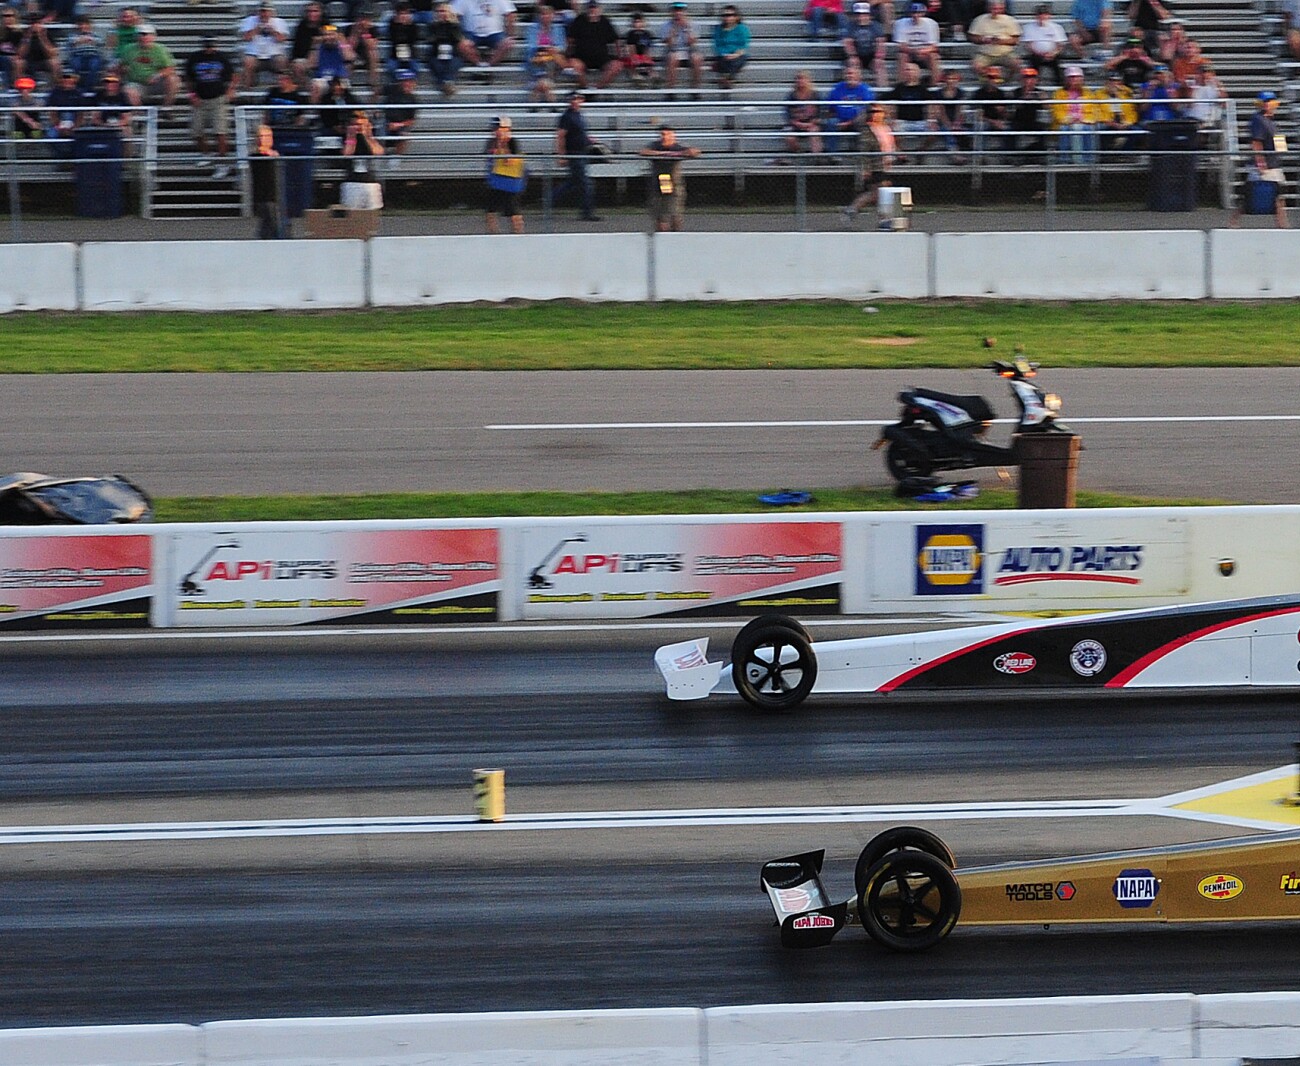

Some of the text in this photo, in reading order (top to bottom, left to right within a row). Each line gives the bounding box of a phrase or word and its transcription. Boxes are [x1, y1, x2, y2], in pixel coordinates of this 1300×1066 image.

[1000, 546, 1145, 572] AUTO PARTS
[623, 562, 684, 572] LIFTS
[275, 569, 337, 579] LIFTS
[1006, 884, 1053, 892] MATCO
[1119, 879, 1155, 898] NAPA
[1203, 881, 1238, 894] PENNZOIL
[1007, 892, 1053, 901] TOOLS
